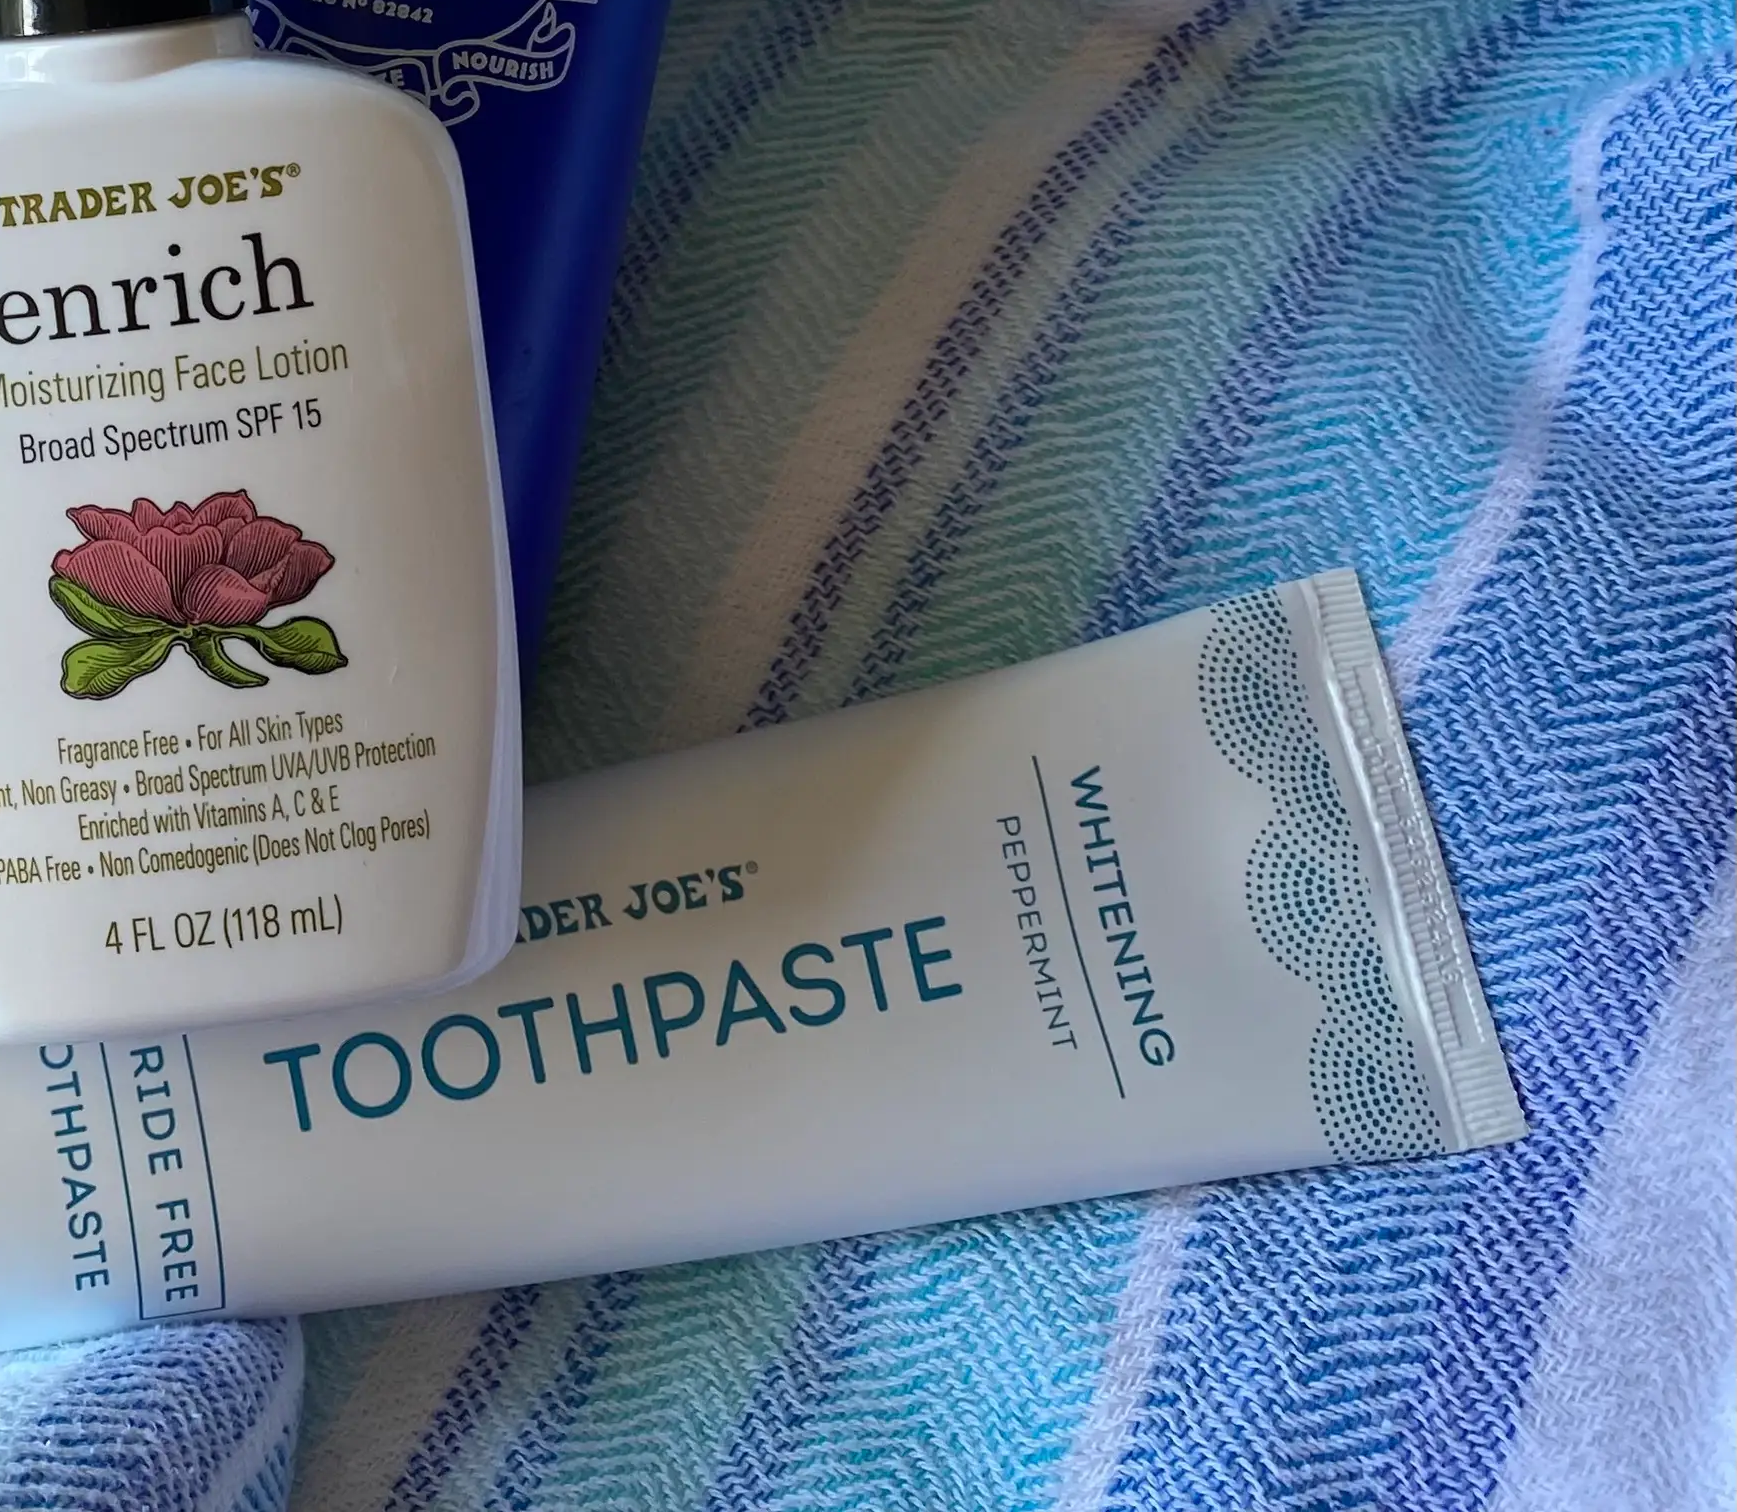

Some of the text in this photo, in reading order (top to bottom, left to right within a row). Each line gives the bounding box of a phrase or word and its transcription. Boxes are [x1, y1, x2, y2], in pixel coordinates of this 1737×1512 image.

[452, 50, 554, 81] NOURISH
[174, 354, 246, 392] Face
[255, 338, 350, 382] Lotion
[18, 398, 323, 465] Broad Spectrum SPF 15
[21, 778, 57, 806] Non
[60, 776, 118, 806] Greasy
[135, 765, 184, 797] Broad
[188, 762, 267, 797] Spectrum
[271, 744, 351, 782] UVA/UVB
[354, 732, 436, 769] Protection
[57, 711, 343, 769] Fragrance Free For All Skin Types
[45, 855, 81, 882] Free
[99, 850, 135, 878] Non
[138, 836, 249, 875] Comedogenic
[253, 833, 300, 866] (Does
[304, 827, 336, 855] Not
[340, 821, 377, 853] Clog
[380, 808, 431, 843] Pores)
[77, 785, 340, 841] Enriched with Vitamins A, C & E
[104, 893, 343, 955] 4 FL OZ (118 mL)
[515, 893, 613, 944] DER
[996, 815, 1078, 1050] PEPPERMINT
[1070, 765, 1175, 1067] WHITENING
[262, 915, 964, 1133] TOOTHPASTE
[39, 1044, 110, 1291] OTHPASTE
[130, 1045, 199, 1303] RIDE FREE
